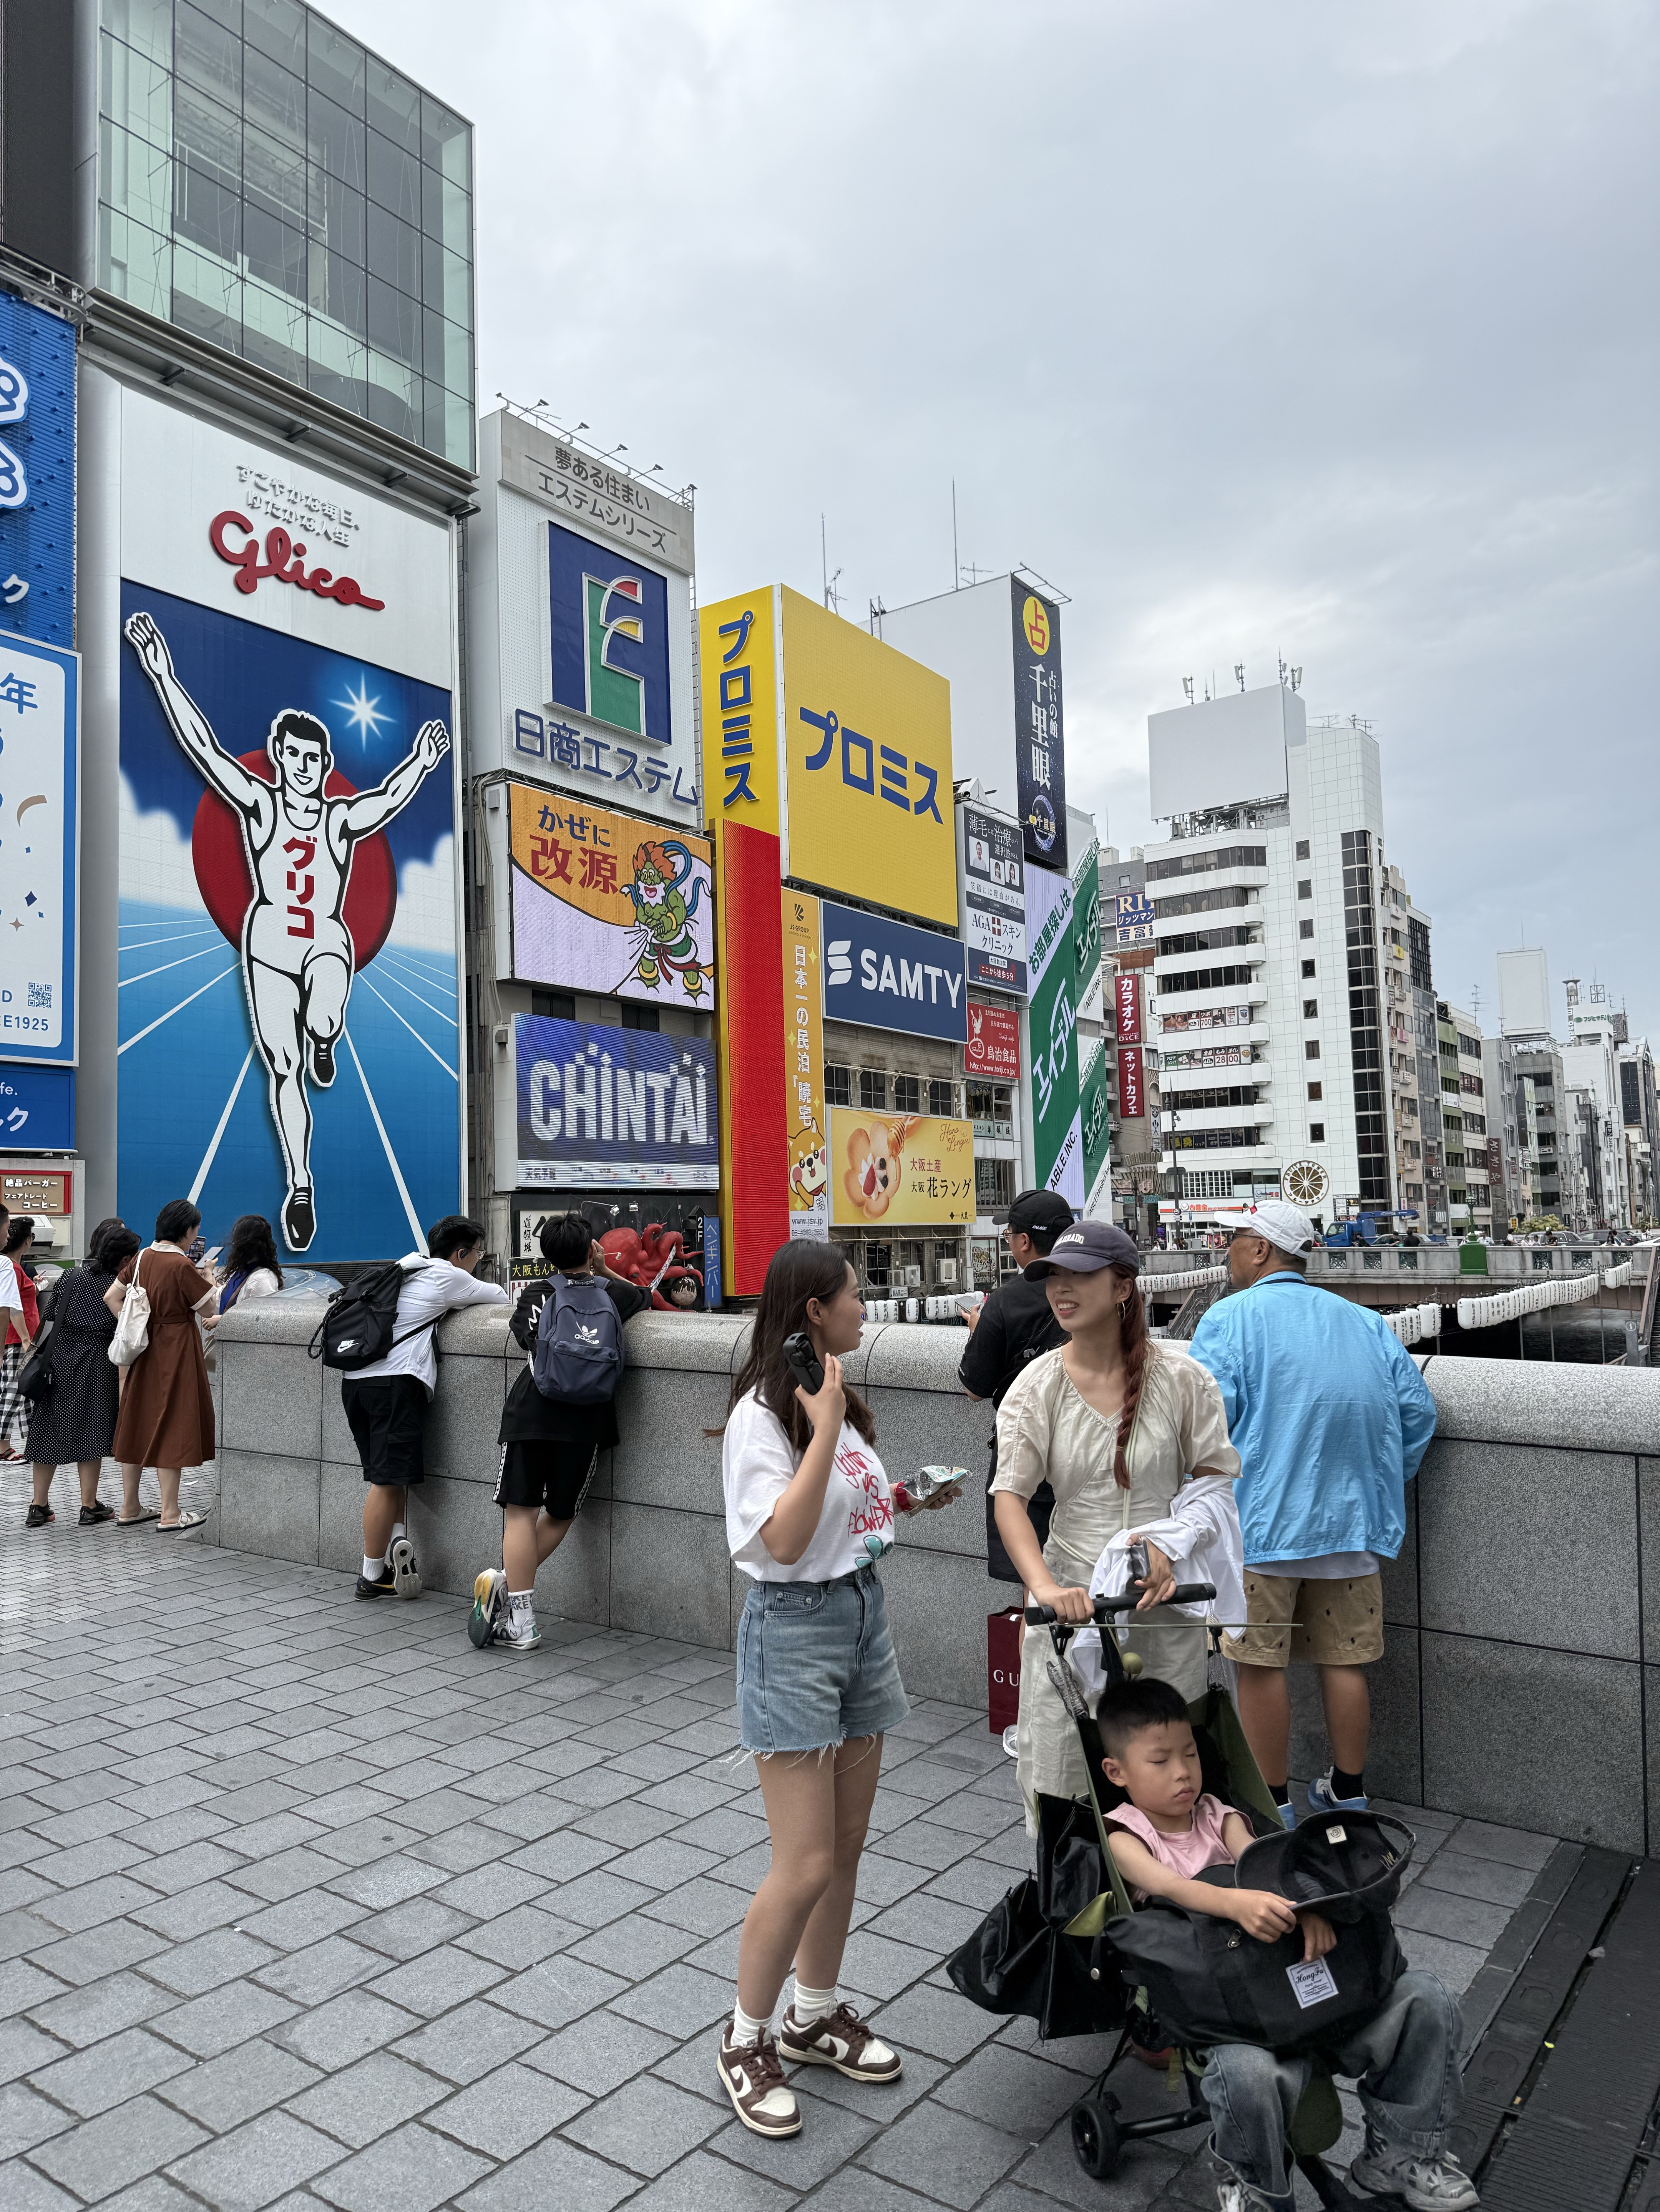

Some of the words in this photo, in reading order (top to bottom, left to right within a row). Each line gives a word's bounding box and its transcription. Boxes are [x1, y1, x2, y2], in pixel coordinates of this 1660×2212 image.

[237, 465, 360, 530] すこやかな毎日、
[555, 446, 649, 510] 夢ある住まい
[247, 490, 350, 547] ゆたかな人生
[539, 472, 666, 553] エステムシリーズ
[210, 511, 385, 611] Glico
[1029, 600, 1046, 650] 占
[718, 610, 759, 808] プロミス
[1029, 664, 1051, 791] 千里眼
[1049, 670, 1058, 738] 占いの館
[515, 708, 698, 806] 日商エステム
[800, 706, 944, 825] プロミス
[538, 805, 610, 847] かぜに
[282, 835, 317, 939] グリコ
[529, 835, 619, 894] 改源
[795, 925, 809, 934] GROUP
[972, 913, 991, 931] AGA
[982, 934, 1013, 956] クリニック
[1002, 924, 1021, 939] スキン
[1029, 887, 1071, 975] お部屋探しは
[1076, 889, 1103, 975] エイブル
[860, 948, 962, 1009] SAMTY
[1121, 978, 1135, 1032] カラオケ
[0, 1014, 48, 1031] E1925
[1033, 977, 1076, 1123] エイブル
[1124, 1050, 1137, 1115] ネットカフェ
[940, 1123, 959, 1142] Hana
[5, 1178, 58, 1187] 絶品バーガー
[910, 1157, 941, 1172] 大阪土産
[911, 1181, 925, 1193] 大阪
[926, 1177, 972, 1198] 花ラング
[697, 1217, 703, 1242] 2F
